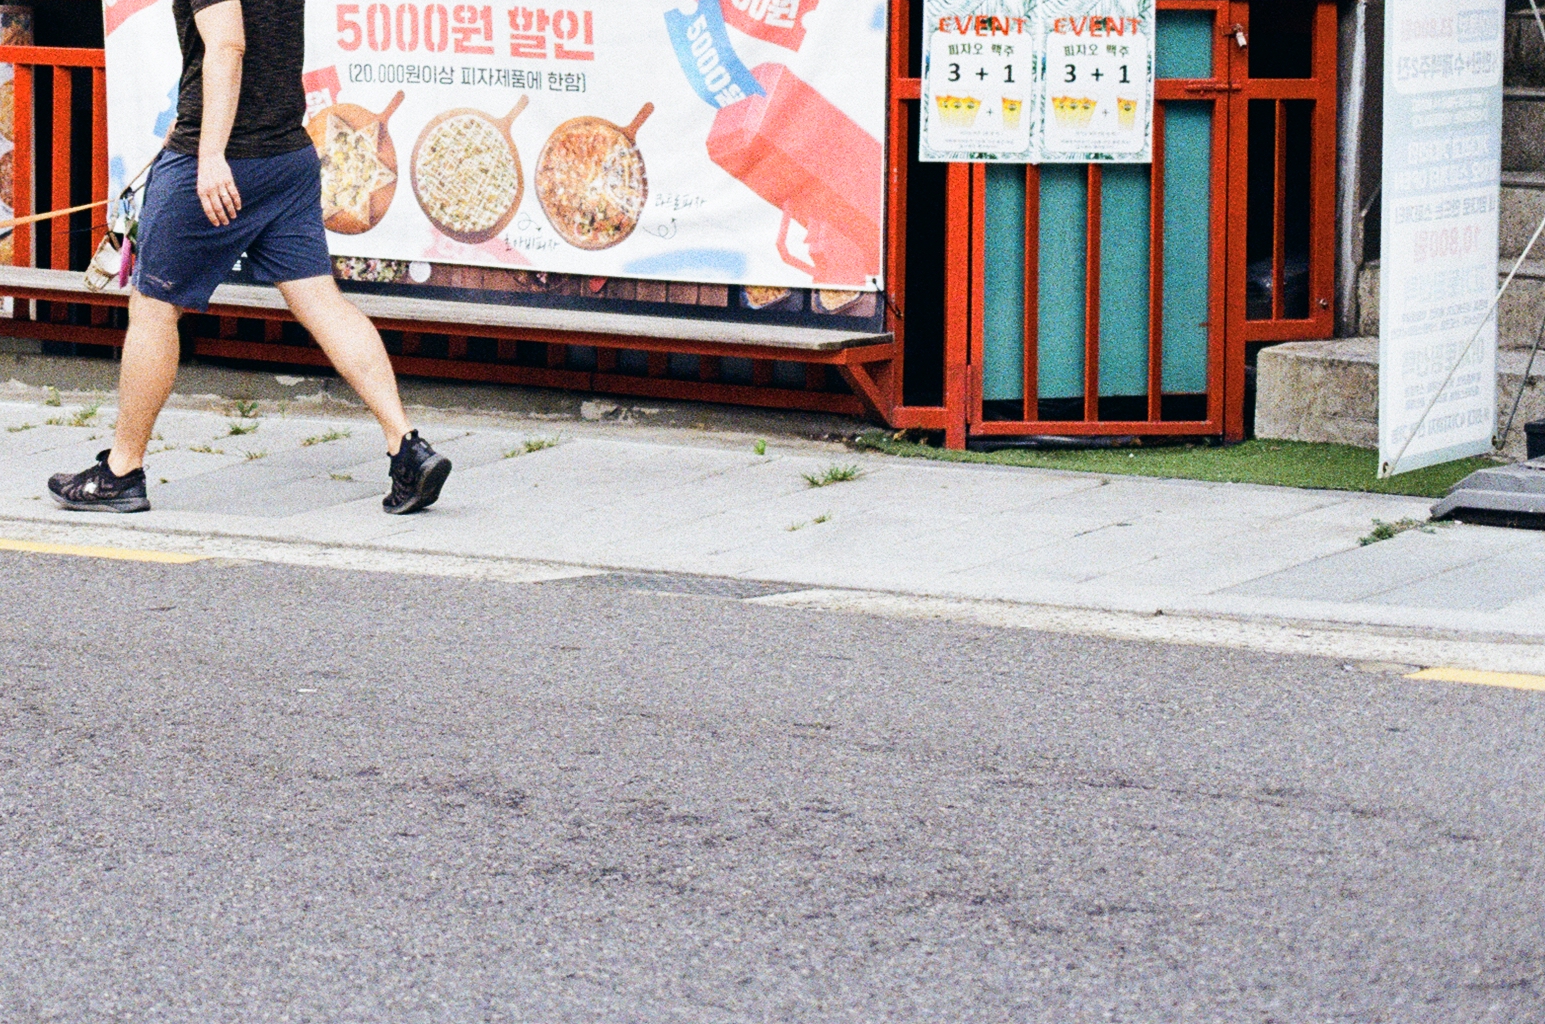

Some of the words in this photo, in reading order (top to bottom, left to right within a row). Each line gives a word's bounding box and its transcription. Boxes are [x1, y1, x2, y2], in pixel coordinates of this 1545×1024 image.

[336, 3, 495, 55] 5000원
[507, 6, 595, 61] 할인
[938, 14, 1027, 37] EVENT
[1053, 15, 1143, 38] EVENT
[948, 43, 983, 57] 피자오
[991, 43, 1015, 57] 맥주
[1063, 44, 1099, 57] 피자오
[1106, 44, 1129, 57] 맥주
[460, 66, 543, 91] 피자제품에
[547, 71, 587, 93] 한함)
[947, 62, 961, 83] 3
[975, 67, 989, 81] +
[1003, 64, 1015, 83] 1
[1063, 63, 1077, 83] 3
[1091, 68, 1104, 82] +
[1118, 65, 1131, 84] 1
